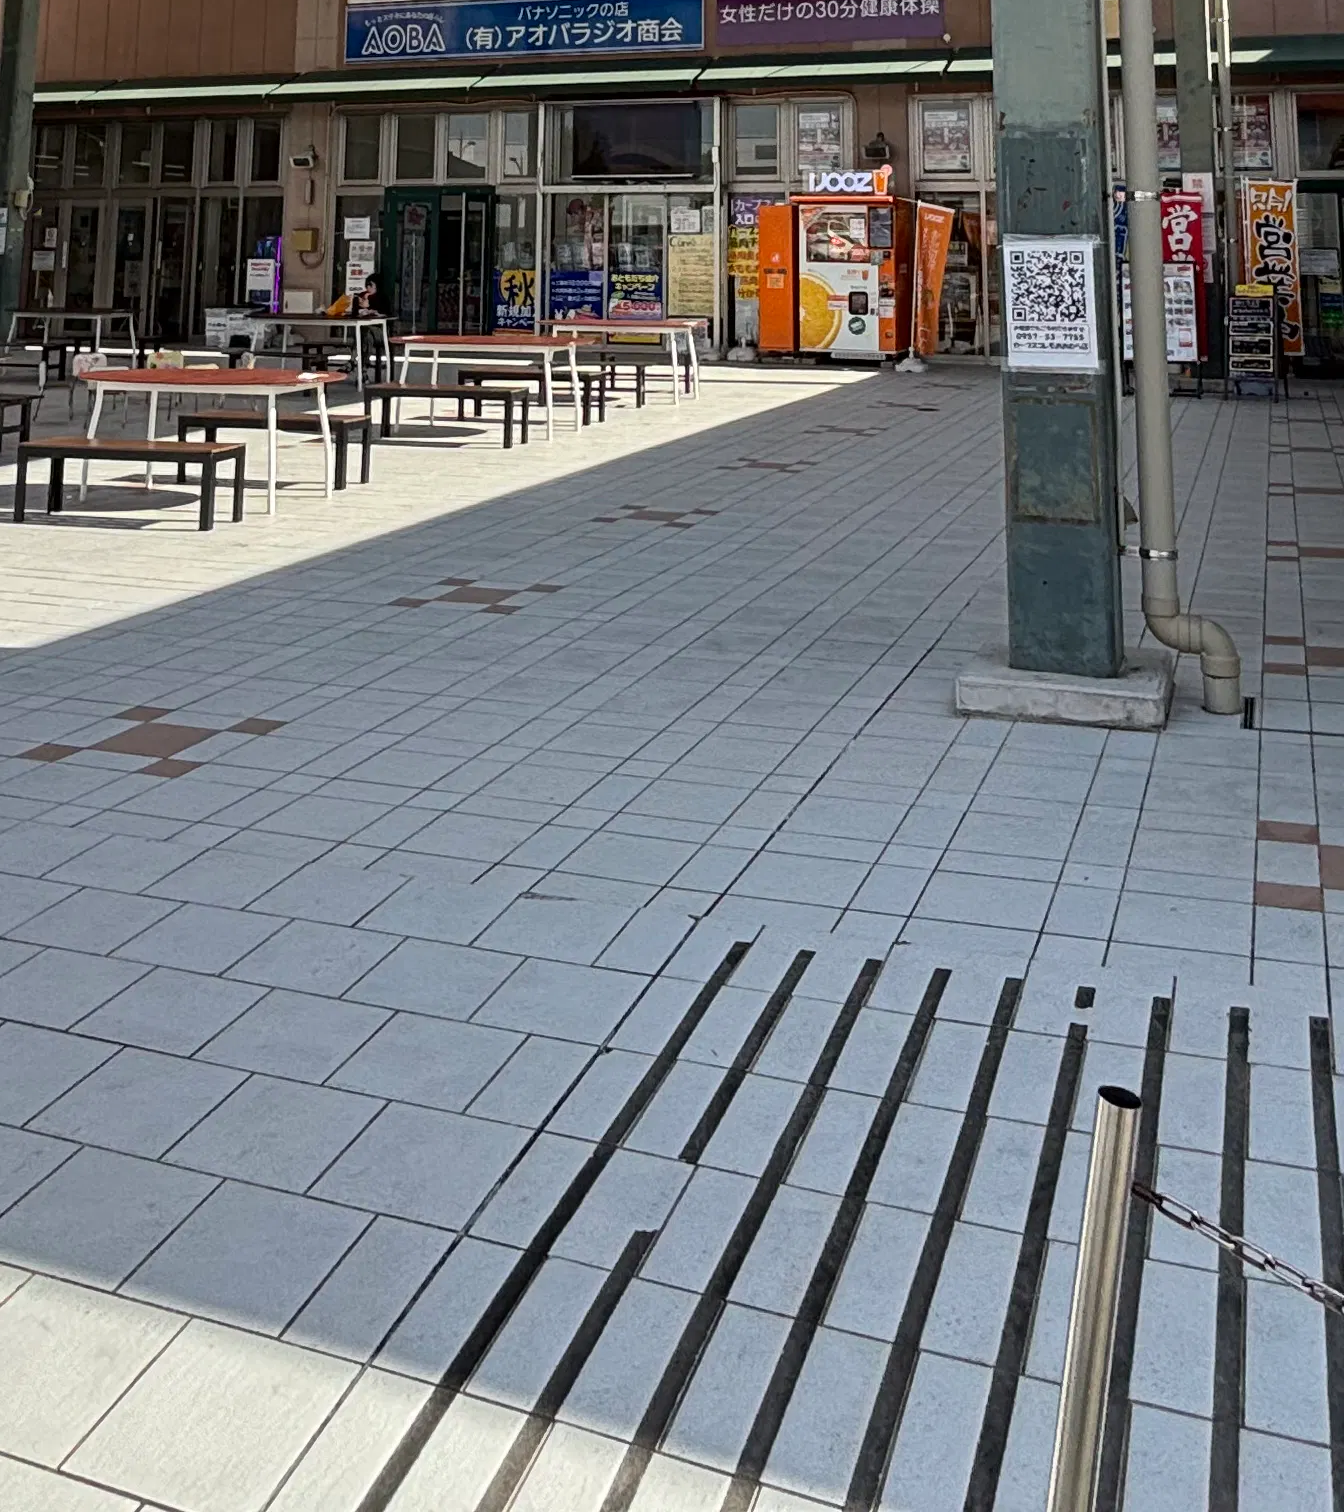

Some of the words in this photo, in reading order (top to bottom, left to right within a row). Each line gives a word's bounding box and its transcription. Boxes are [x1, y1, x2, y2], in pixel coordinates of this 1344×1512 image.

[517, 1, 629, 21] パナソニックの店
[362, 24, 446, 55] AOBA
[1161, 204, 1199, 262] 営
[496, 304, 537, 318] 新規加
